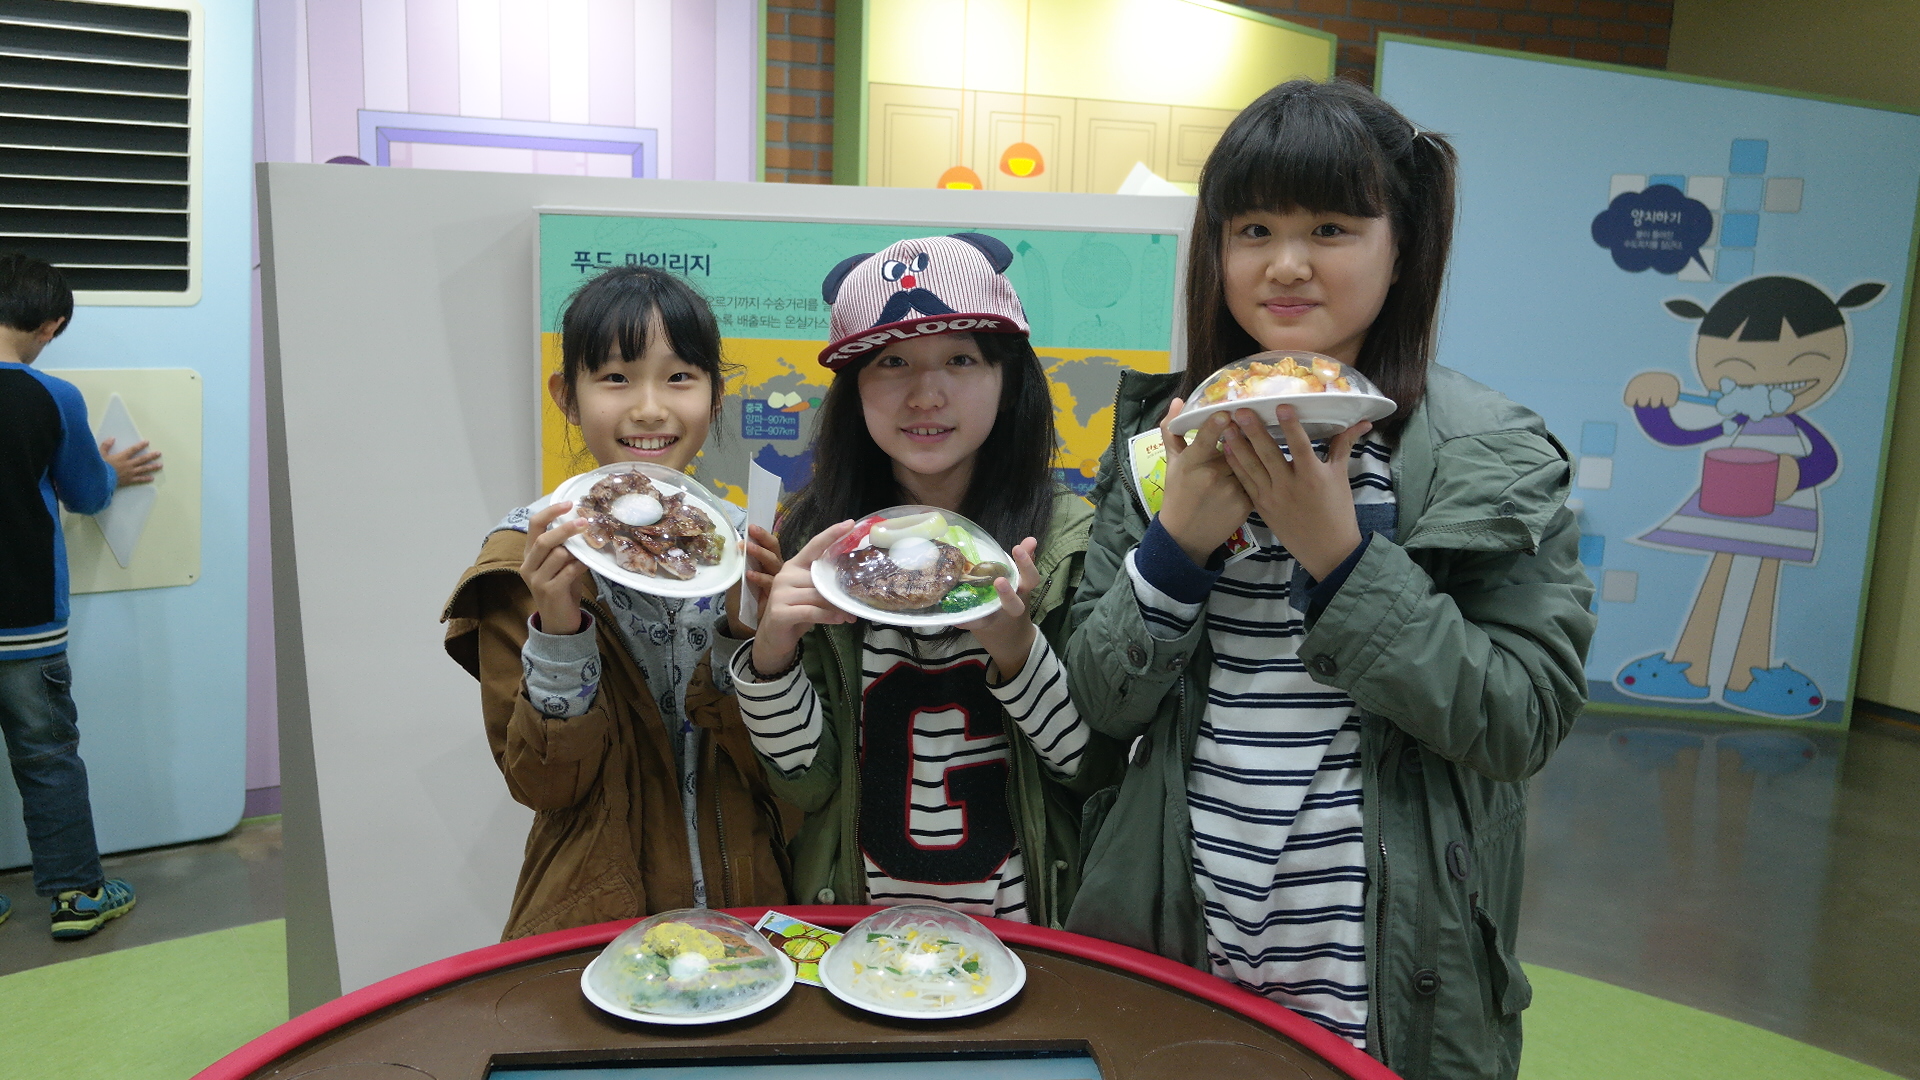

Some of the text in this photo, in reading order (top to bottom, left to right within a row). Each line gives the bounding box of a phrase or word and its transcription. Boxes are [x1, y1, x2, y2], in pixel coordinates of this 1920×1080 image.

[1631, 208, 1681, 227] 양치하기
[571, 251, 613, 274] 푸드
[763, 297, 819, 312] 수송거리를
[737, 314, 781, 328] 배출되는
[826, 318, 1000, 363] TOPLOOK
[859, 659, 1016, 886] G
